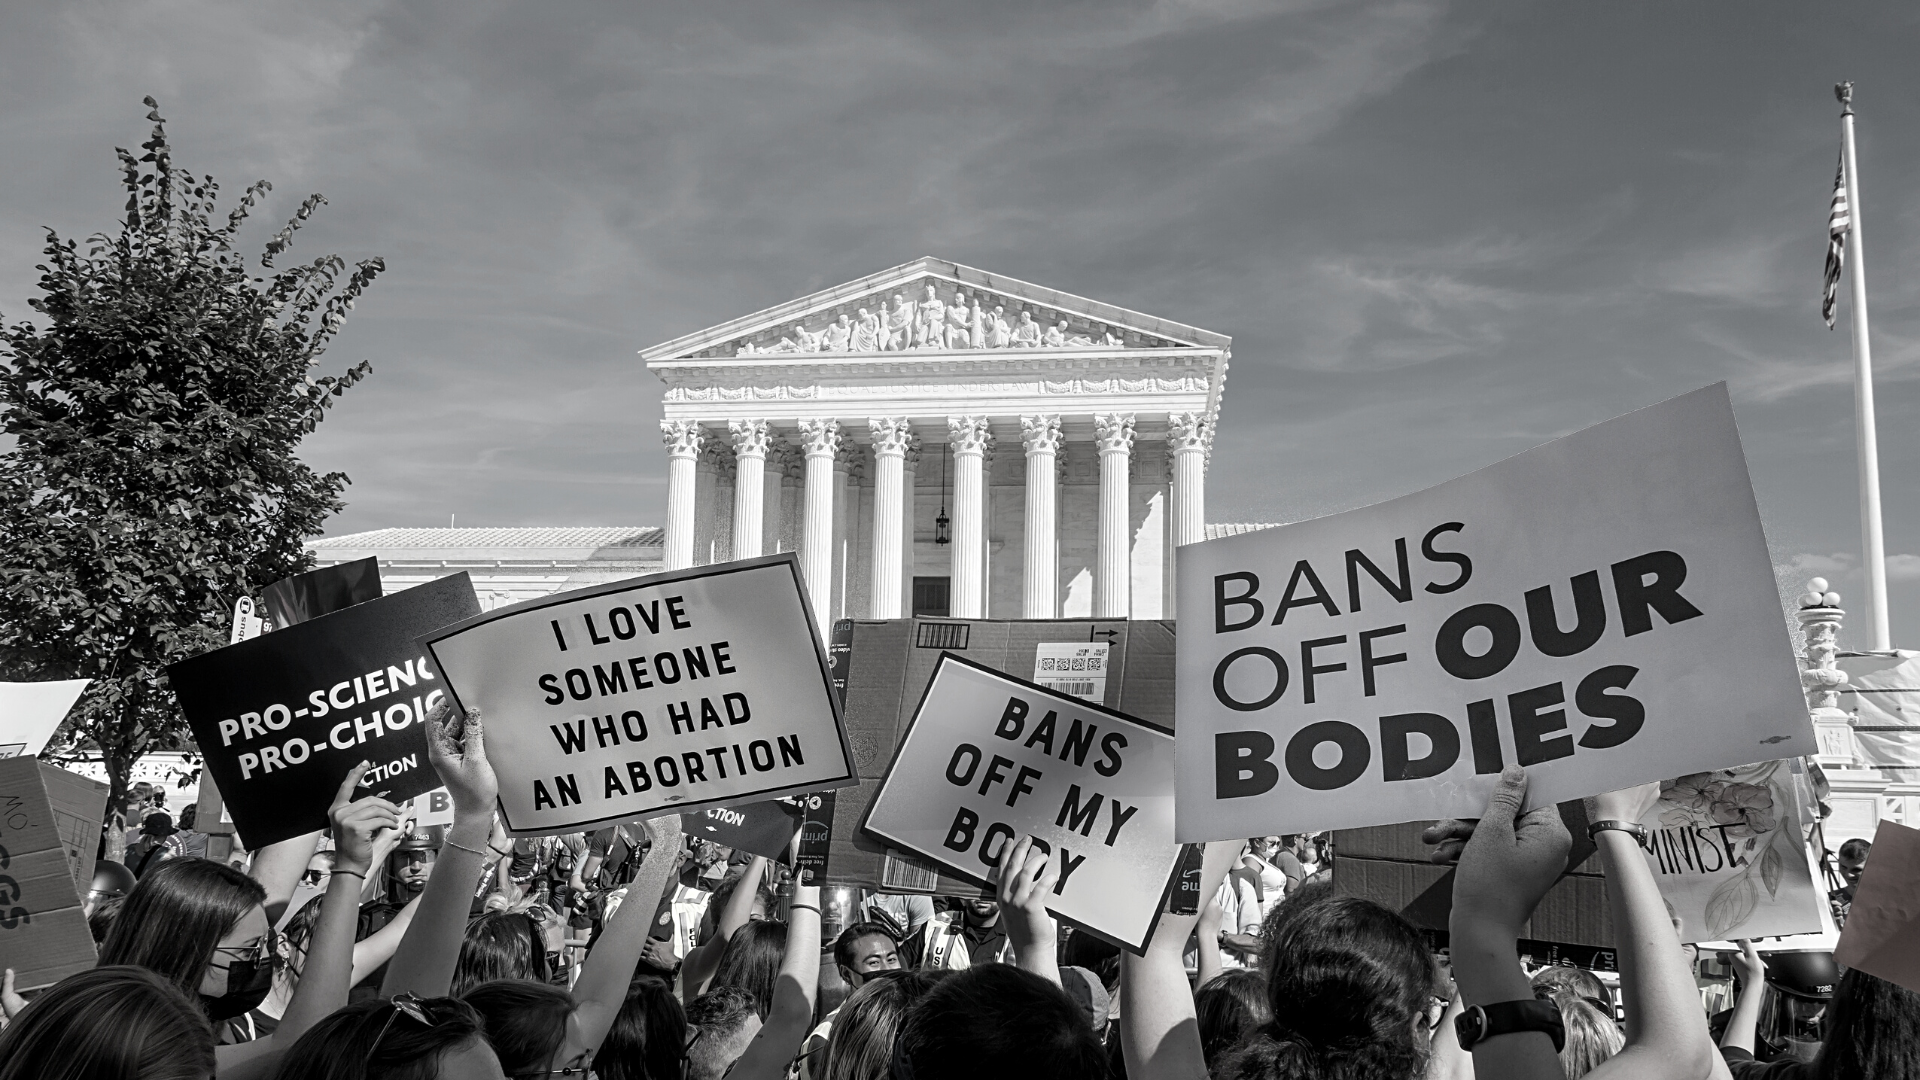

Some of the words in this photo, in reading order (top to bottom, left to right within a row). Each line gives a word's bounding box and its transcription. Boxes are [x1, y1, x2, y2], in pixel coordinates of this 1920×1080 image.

[828, 383, 877, 396] EQUAL
[881, 381, 939, 394] JUSTICE
[947, 380, 995, 393] UNDER
[1002, 380, 1031, 392] LAW
[1215, 521, 1473, 634] BANS
[550, 620, 567, 651] I
[584, 596, 692, 646] LOVE
[1212, 624, 1408, 711] OFF
[1435, 550, 1704, 680] OUR
[538, 641, 737, 705] SOMEONE
[550, 709, 648, 756] WHO
[667, 692, 752, 735] HAD
[995, 697, 1128, 777] BANS
[1214, 665, 1646, 800] BODIES
[532, 773, 582, 811] AN
[603, 734, 805, 799] ABORTION
[945, 743, 1043, 808] OFF
[1055, 784, 1138, 847] MY
